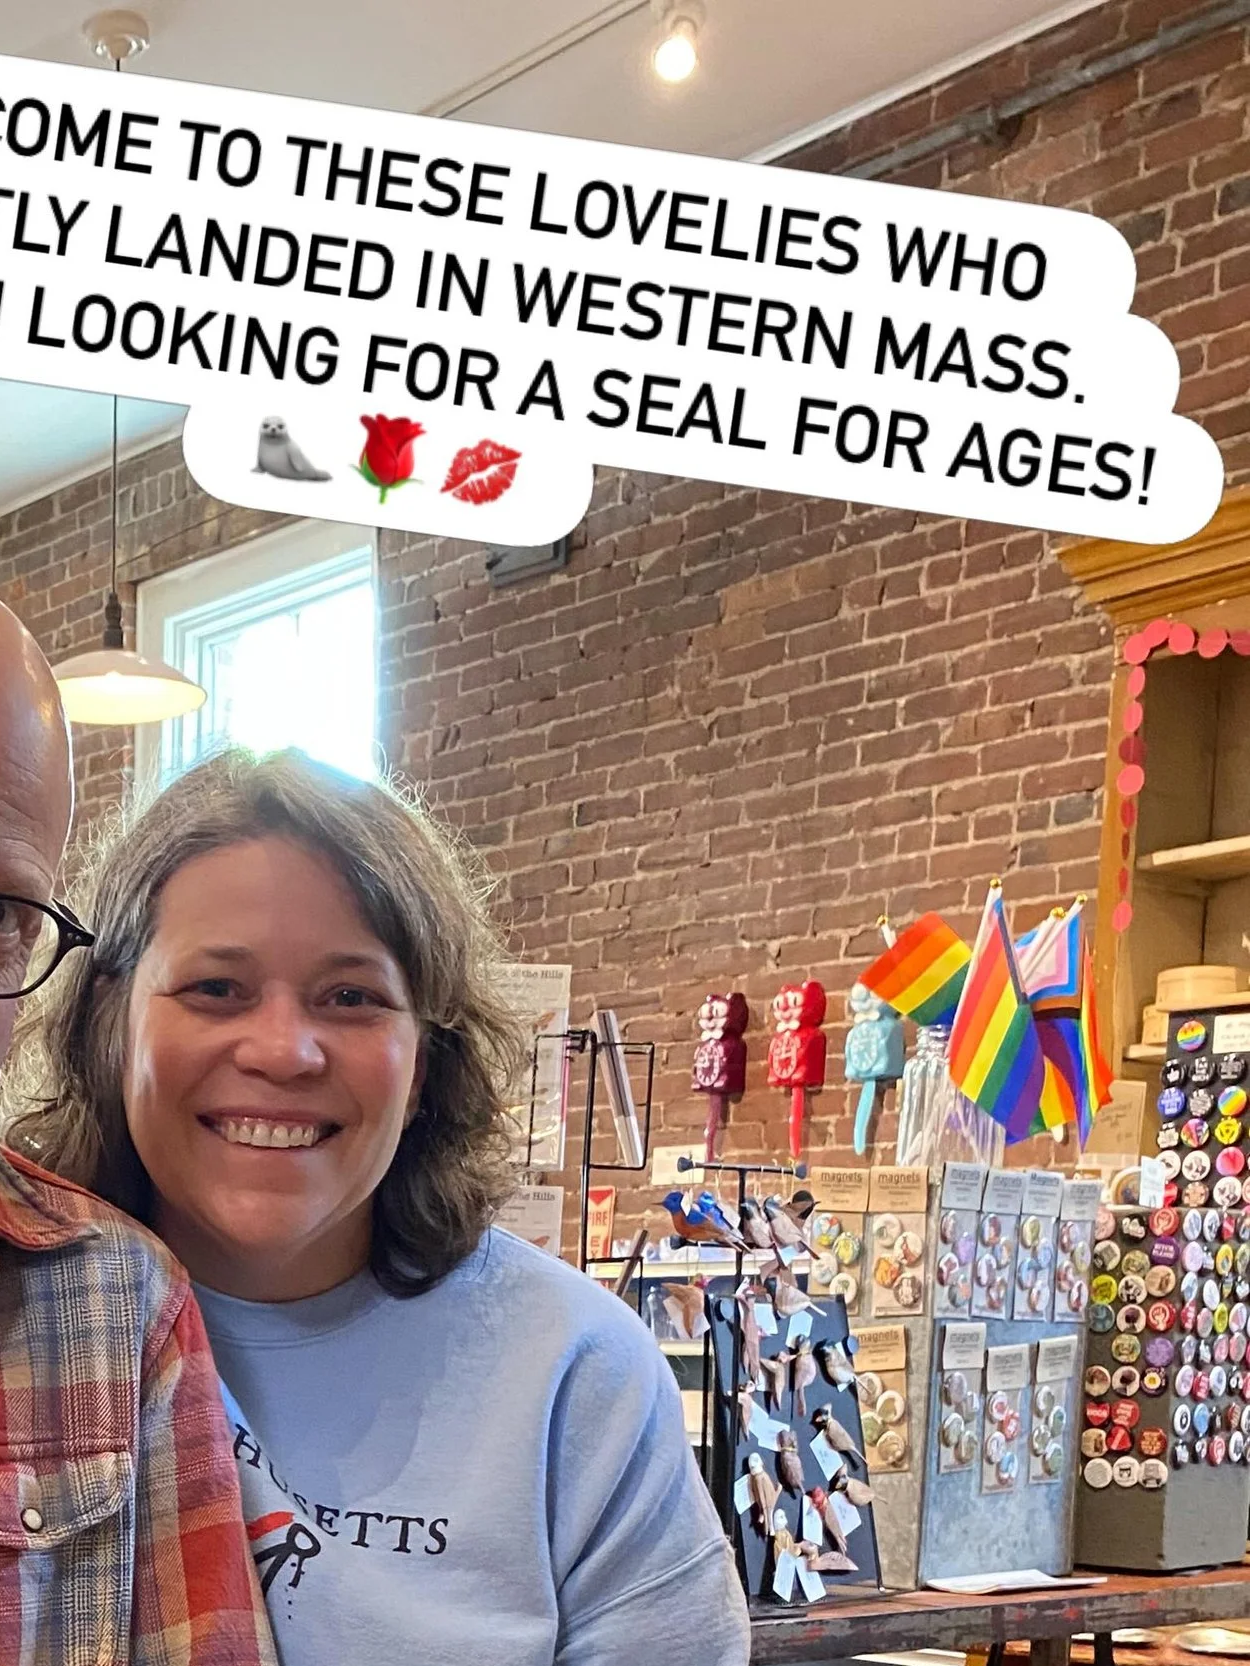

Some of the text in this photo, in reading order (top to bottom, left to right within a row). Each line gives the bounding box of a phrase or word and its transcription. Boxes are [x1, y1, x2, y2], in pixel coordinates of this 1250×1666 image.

[821, 1171, 862, 1182] magnets
[878, 1172, 920, 1184] magnets
[857, 1328, 899, 1344] magnets
[233, 1423, 449, 1555] HUSETTS
